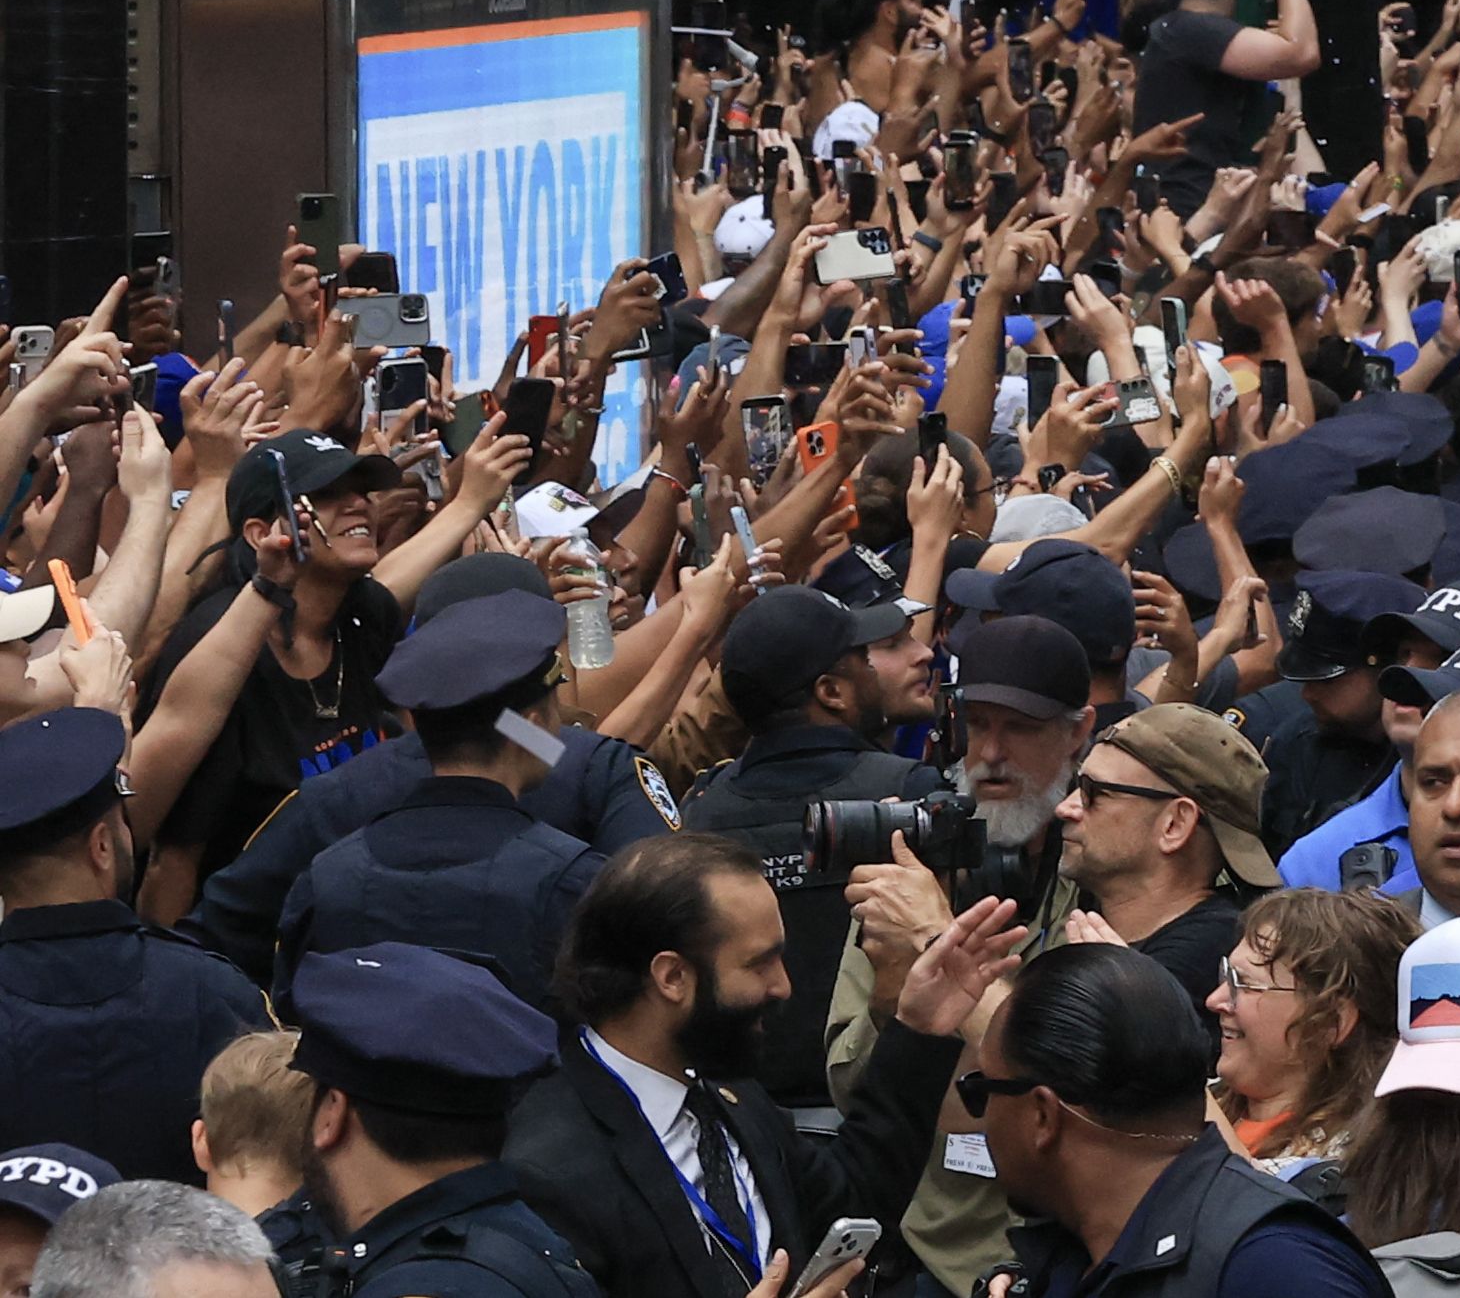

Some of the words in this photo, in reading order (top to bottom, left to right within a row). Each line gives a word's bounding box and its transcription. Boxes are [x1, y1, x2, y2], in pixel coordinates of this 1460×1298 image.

[376, 149, 487, 382] NEW
[496, 133, 619, 356] YORK
[762, 854, 803, 867] NYP
[776, 876, 803, 889] K9
